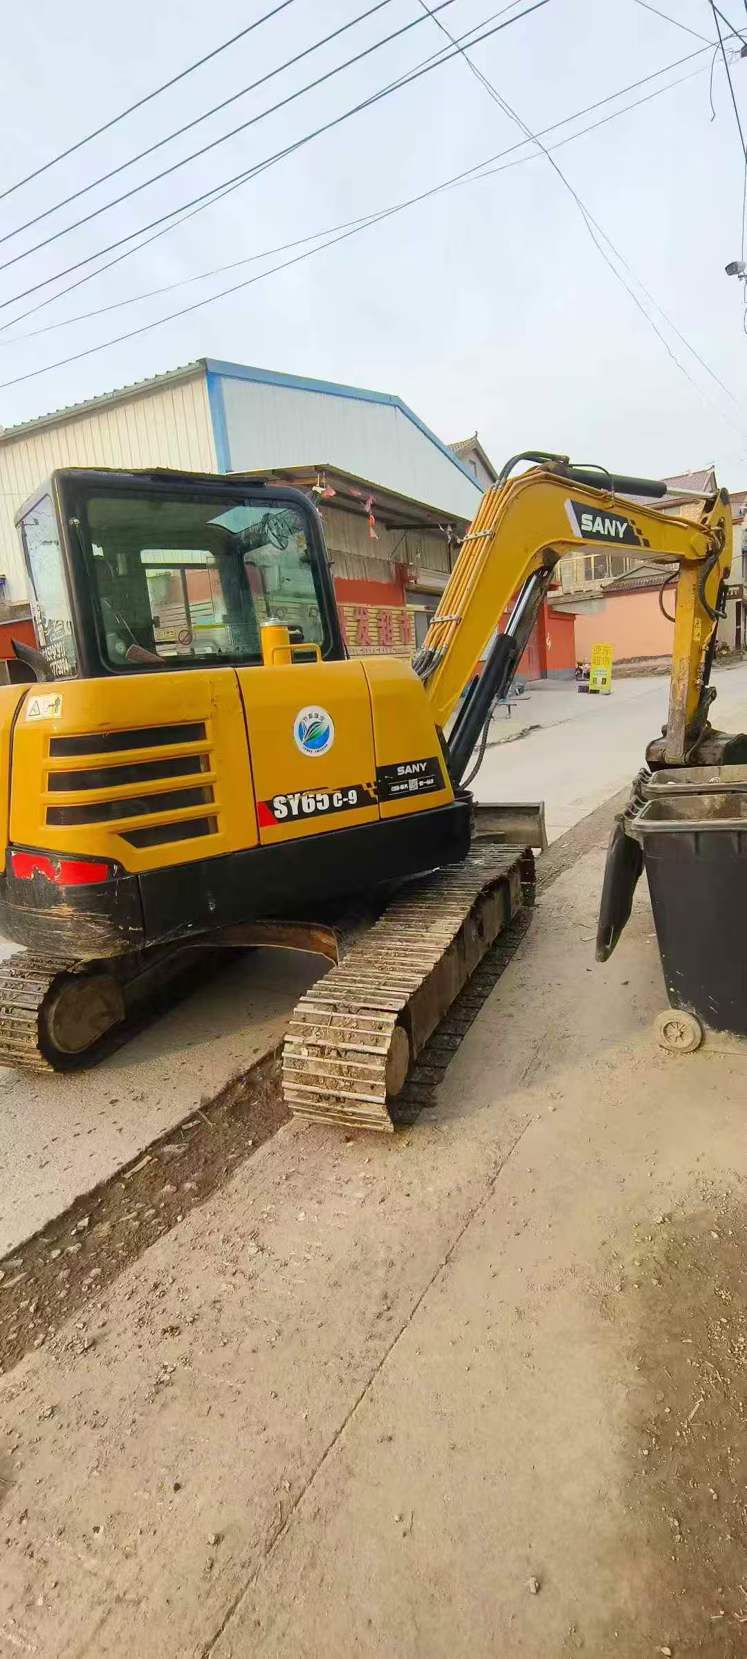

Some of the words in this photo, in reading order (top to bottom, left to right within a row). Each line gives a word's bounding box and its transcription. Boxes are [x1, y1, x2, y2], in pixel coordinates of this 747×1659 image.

[581, 513, 628, 538] SANY
[396, 762, 427, 776] SANY
[272, 792, 330, 819] SY65
[332, 789, 358, 808] C-9
